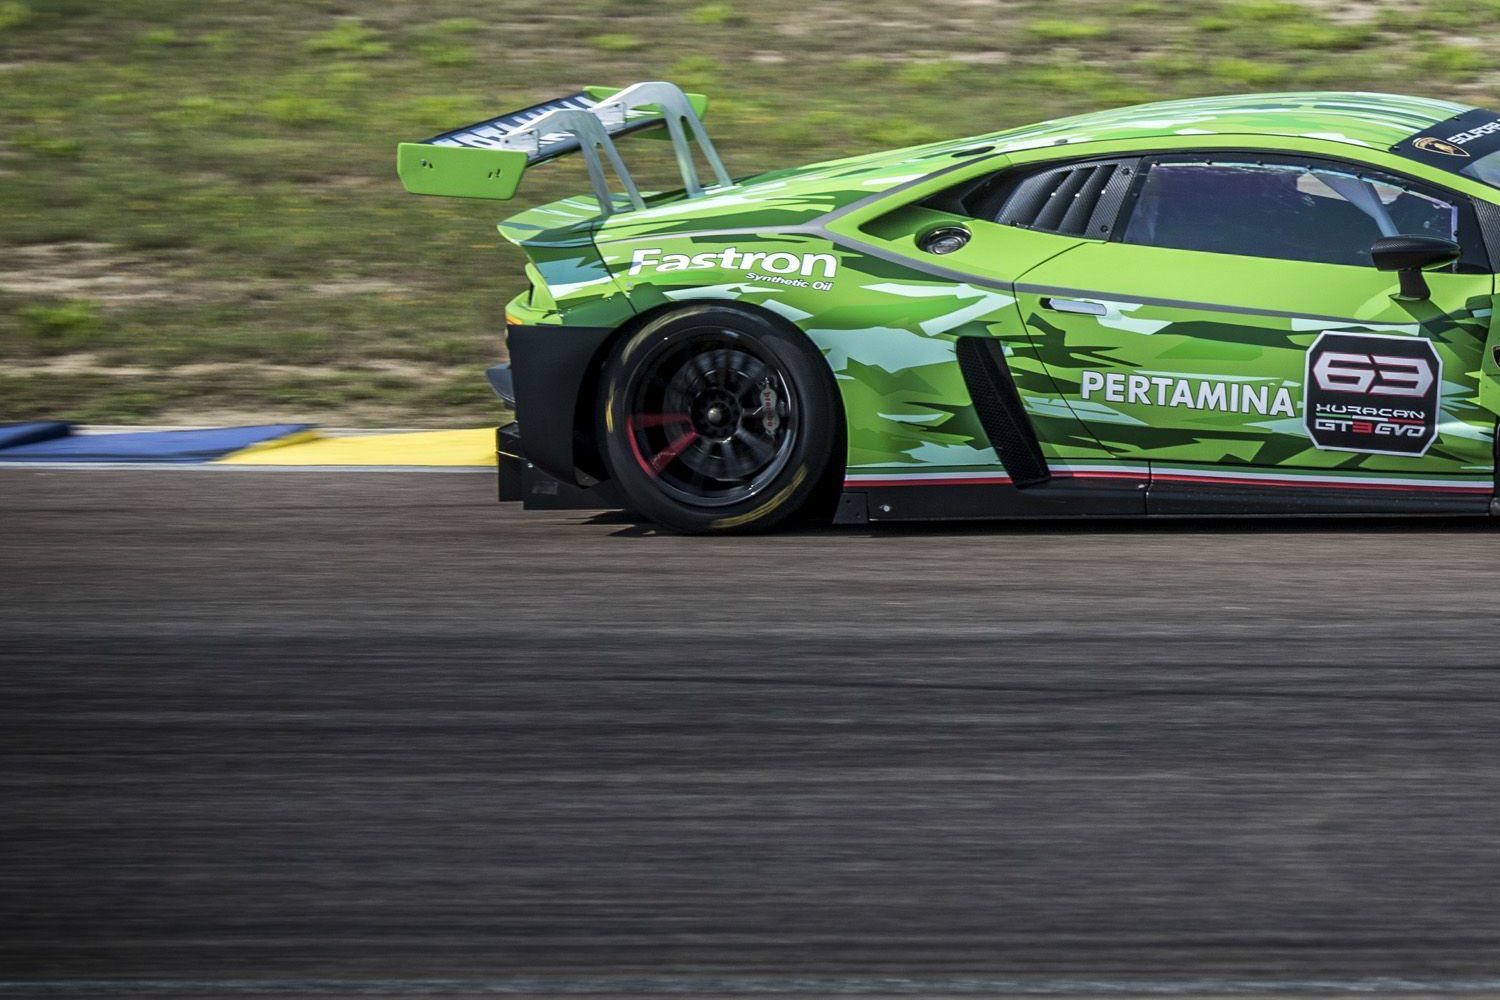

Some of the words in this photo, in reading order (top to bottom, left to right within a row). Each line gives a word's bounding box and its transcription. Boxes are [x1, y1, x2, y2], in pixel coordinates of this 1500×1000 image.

[628, 247, 837, 278] Fastron
[745, 272, 809, 288] Synthetic
[812, 281, 833, 291] Oil
[1313, 351, 1434, 398] 63
[764, 391, 774, 427] brebo
[1081, 371, 1296, 417] PERTAMINA
[1375, 423, 1426, 437] EVO
